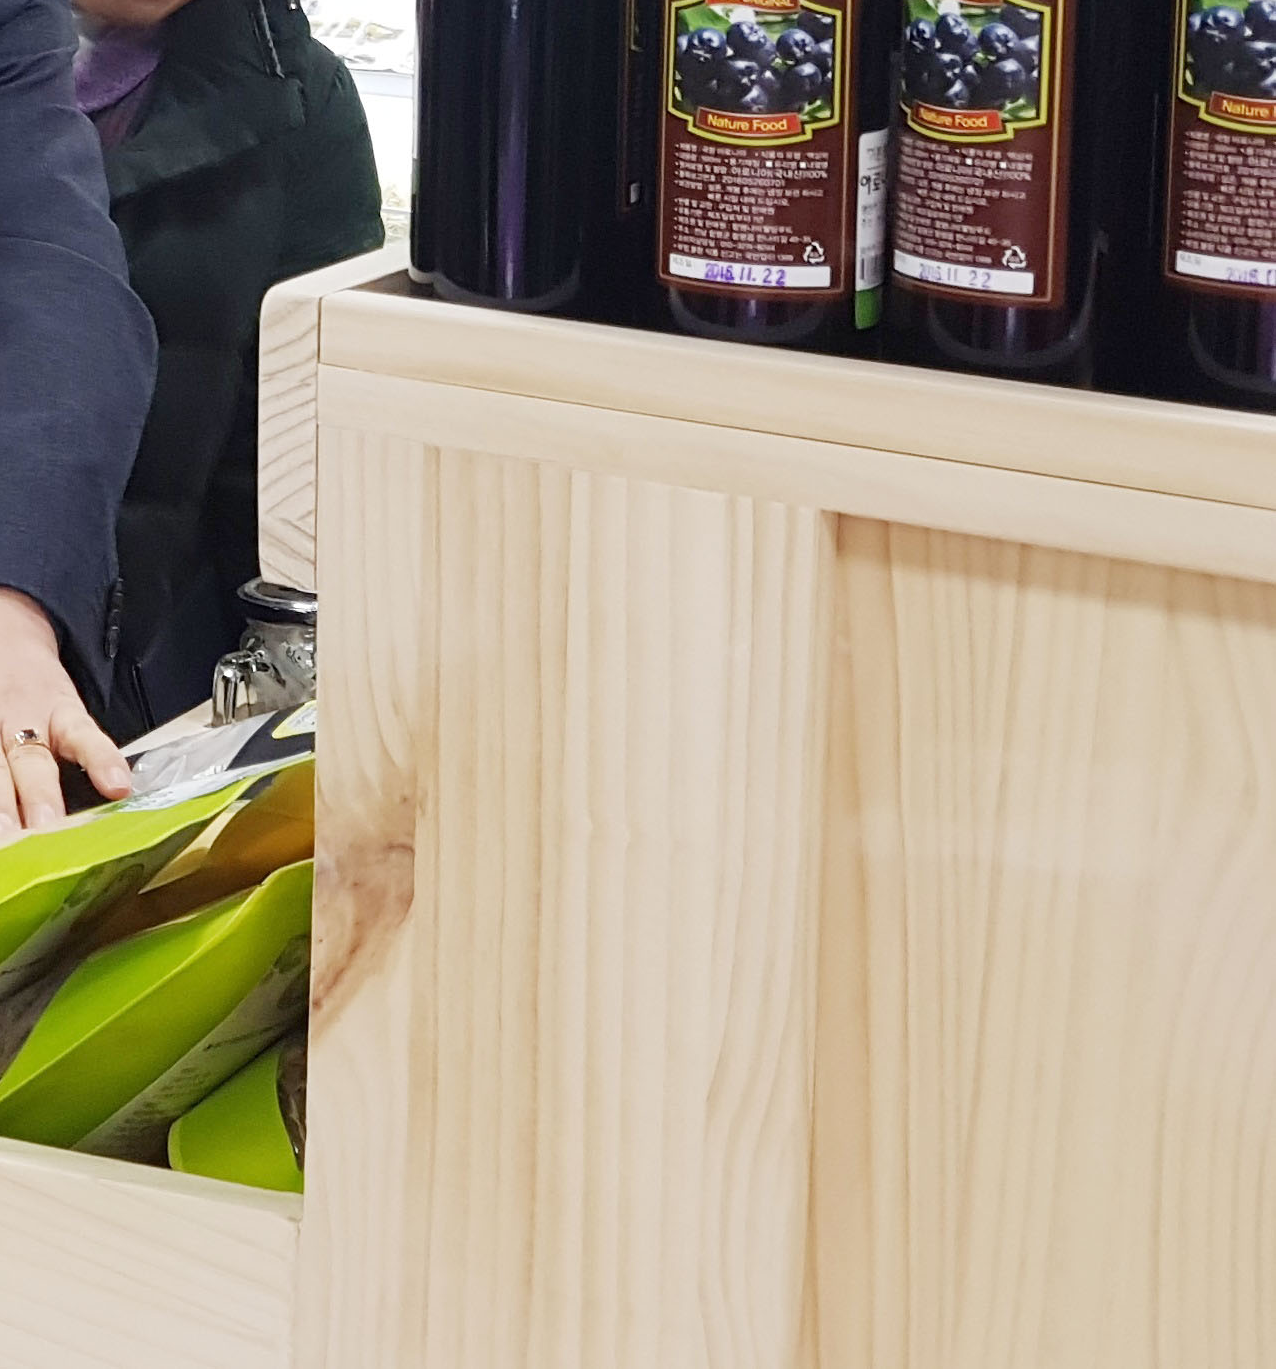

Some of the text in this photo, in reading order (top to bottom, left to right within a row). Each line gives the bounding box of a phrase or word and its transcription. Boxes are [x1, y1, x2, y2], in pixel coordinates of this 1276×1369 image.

[919, 107, 988, 128] Nature Food
[1222, 99, 1270, 118] Nature
[706, 113, 788, 132] Nature Food
